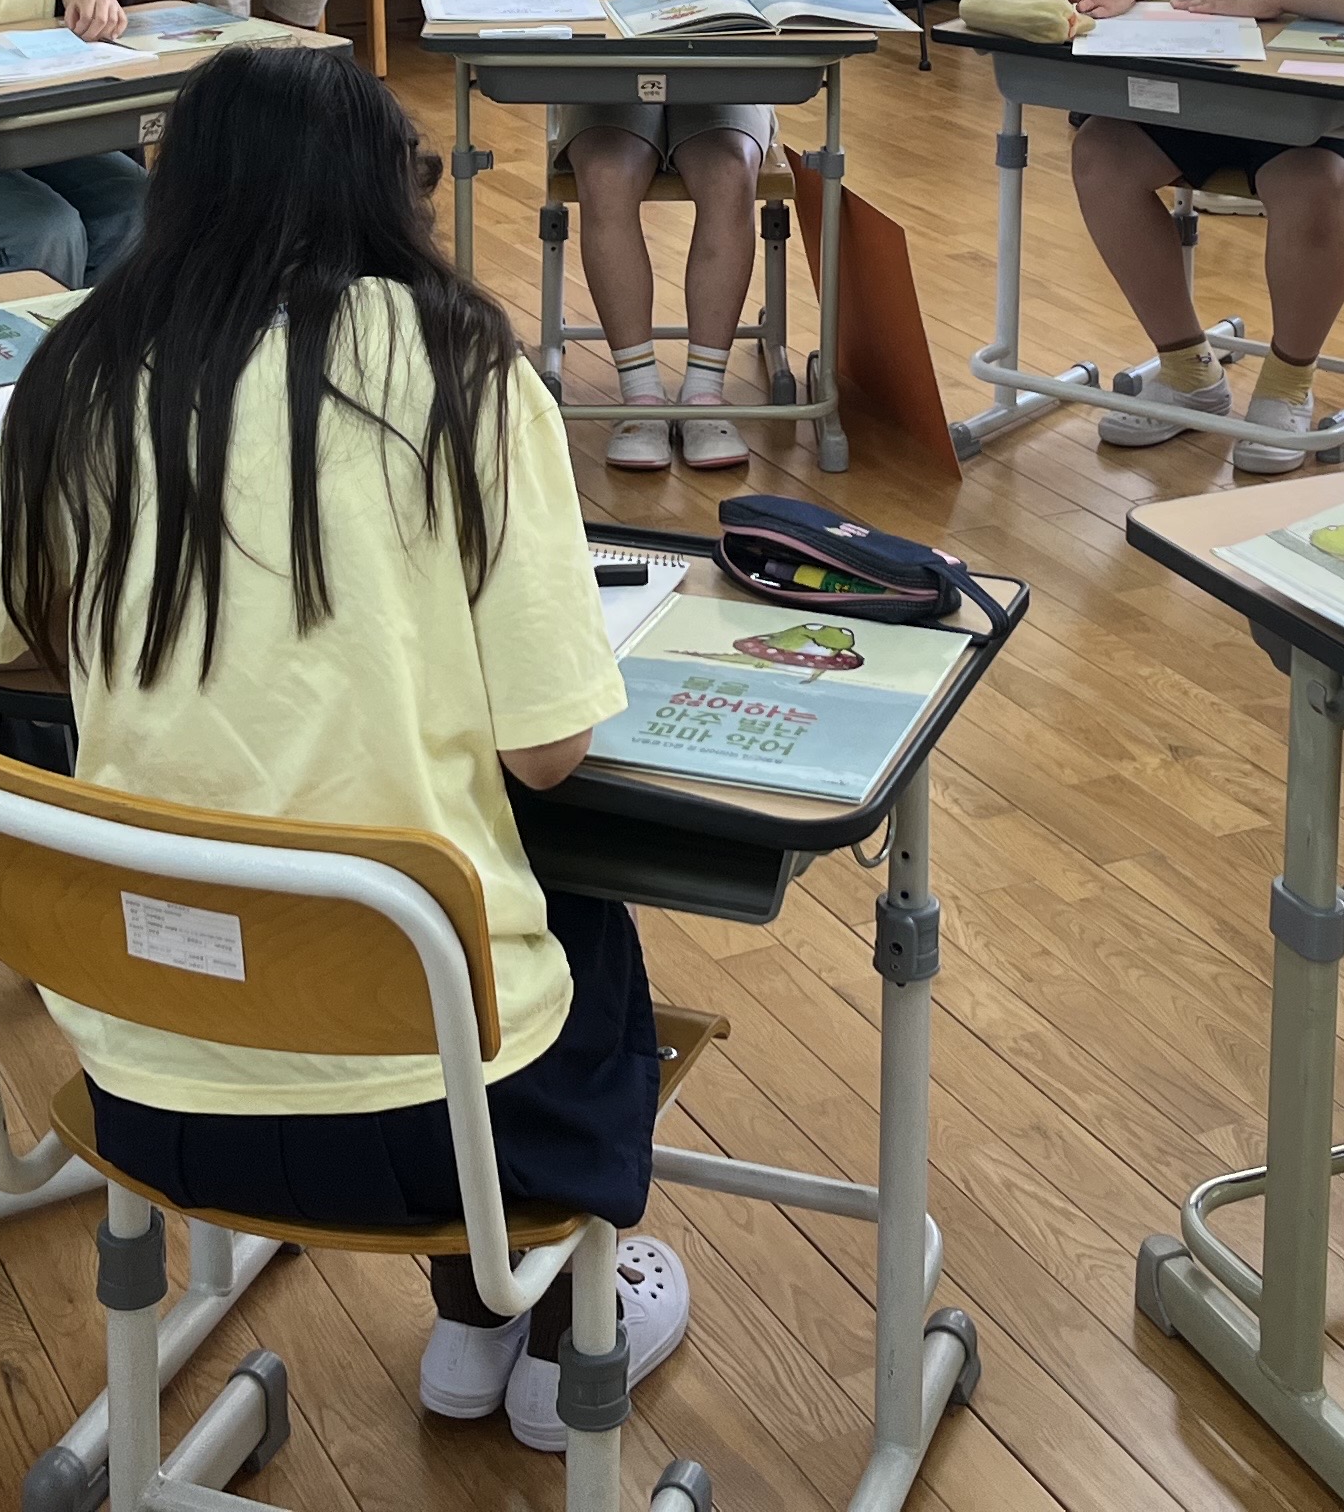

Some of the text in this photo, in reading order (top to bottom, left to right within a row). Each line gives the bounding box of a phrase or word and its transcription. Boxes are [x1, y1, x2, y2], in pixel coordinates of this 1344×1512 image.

[656, 706, 808, 740] 아주 별난
[669, 691, 818, 726] 싫어하는
[639, 721, 712, 743] 꼬마
[726, 733, 795, 756] 악어
